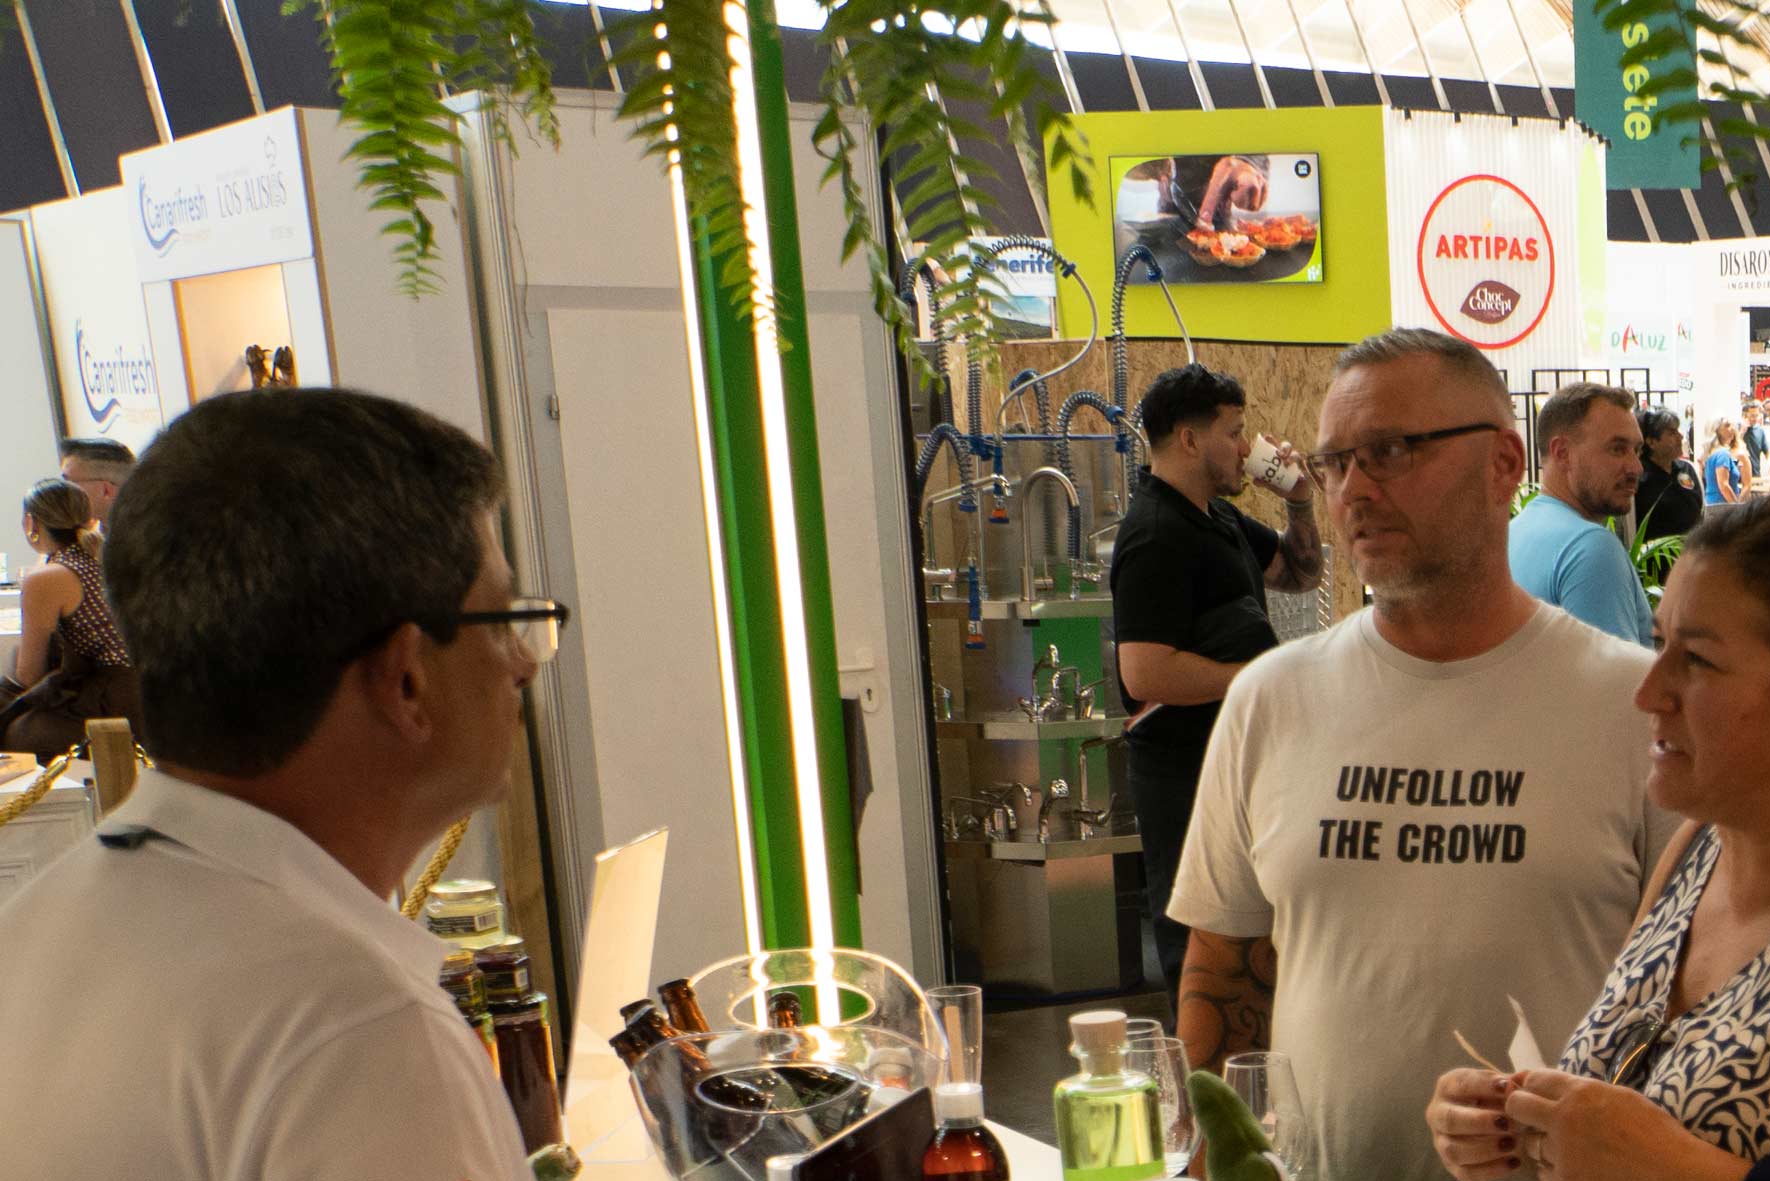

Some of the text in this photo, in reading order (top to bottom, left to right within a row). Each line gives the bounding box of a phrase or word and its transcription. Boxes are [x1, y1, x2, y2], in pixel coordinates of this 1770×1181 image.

[1622, 22, 1658, 141] sete
[216, 181, 242, 218] LOS
[1435, 234, 1539, 261] ARTIPAS
[1469, 297, 1512, 316] Concept
[1476, 287, 1504, 302] Choc
[1337, 766, 1525, 807] UNFOLLOW
[1319, 819, 1526, 864] THE CROWD
